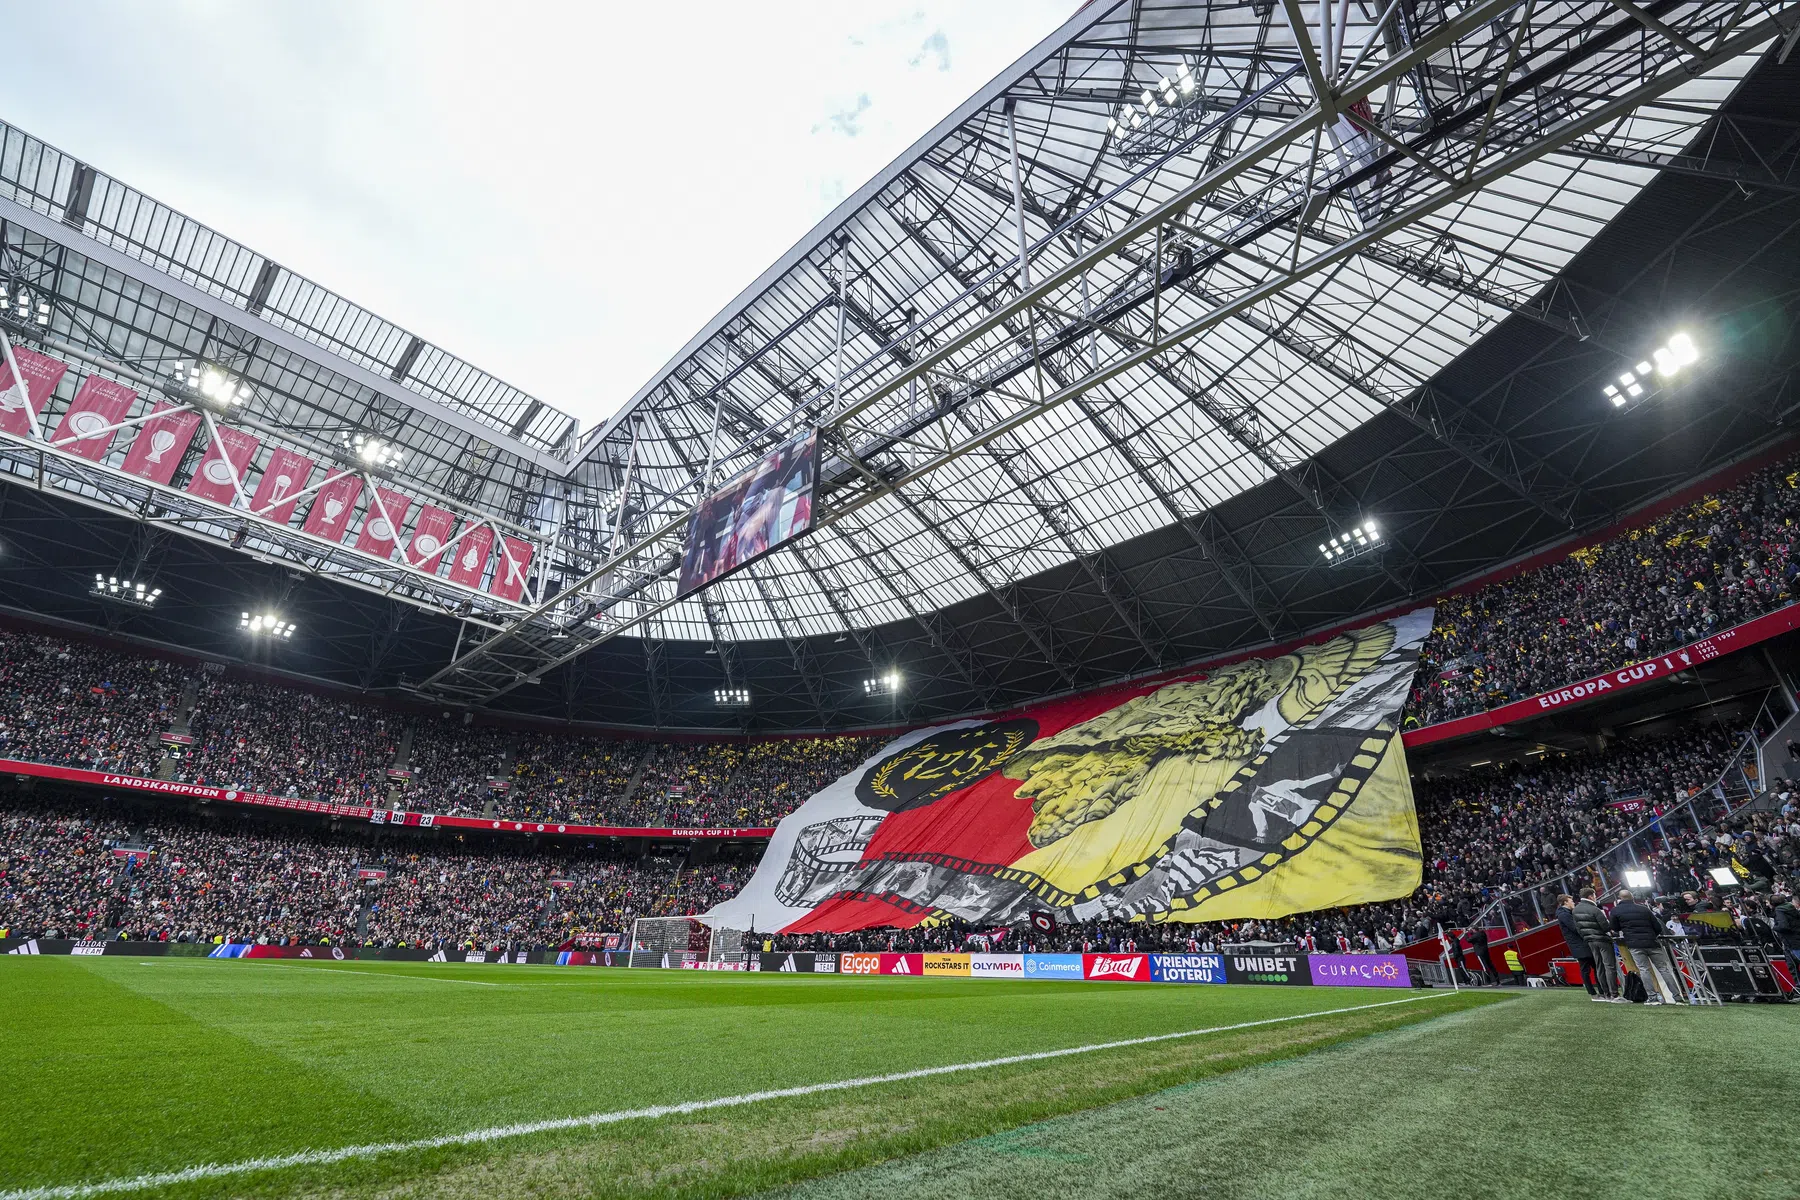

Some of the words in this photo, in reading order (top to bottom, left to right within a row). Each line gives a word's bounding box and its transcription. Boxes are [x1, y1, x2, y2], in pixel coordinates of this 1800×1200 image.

[18, 356, 55, 373] NATIONALE
[1695, 640, 1711, 650] 1971
[1717, 630, 1735, 641] 1995
[1699, 645, 1716, 655] 1972
[1702, 650, 1720, 660] 1973
[1538, 679, 1612, 709] EUROPA
[1617, 662, 1656, 684] CUP
[103, 775, 219, 797] LANDSKAMPIOEN
[74, 940, 107, 948] ADIDAS
[815, 953, 836, 962] ADIDAS
[1153, 955, 1219, 969] VRIENDEN
[820, 963, 834, 971] TEAM
[925, 962, 961, 970] ROCKSTARS
[962, 962, 970, 970] IT
[972, 962, 1022, 971] OLYMPIA
[1038, 962, 1080, 972] Coinmerce
[1233, 957, 1297, 972] UNIBET
[1162, 968, 1213, 982] LOTERIJ
